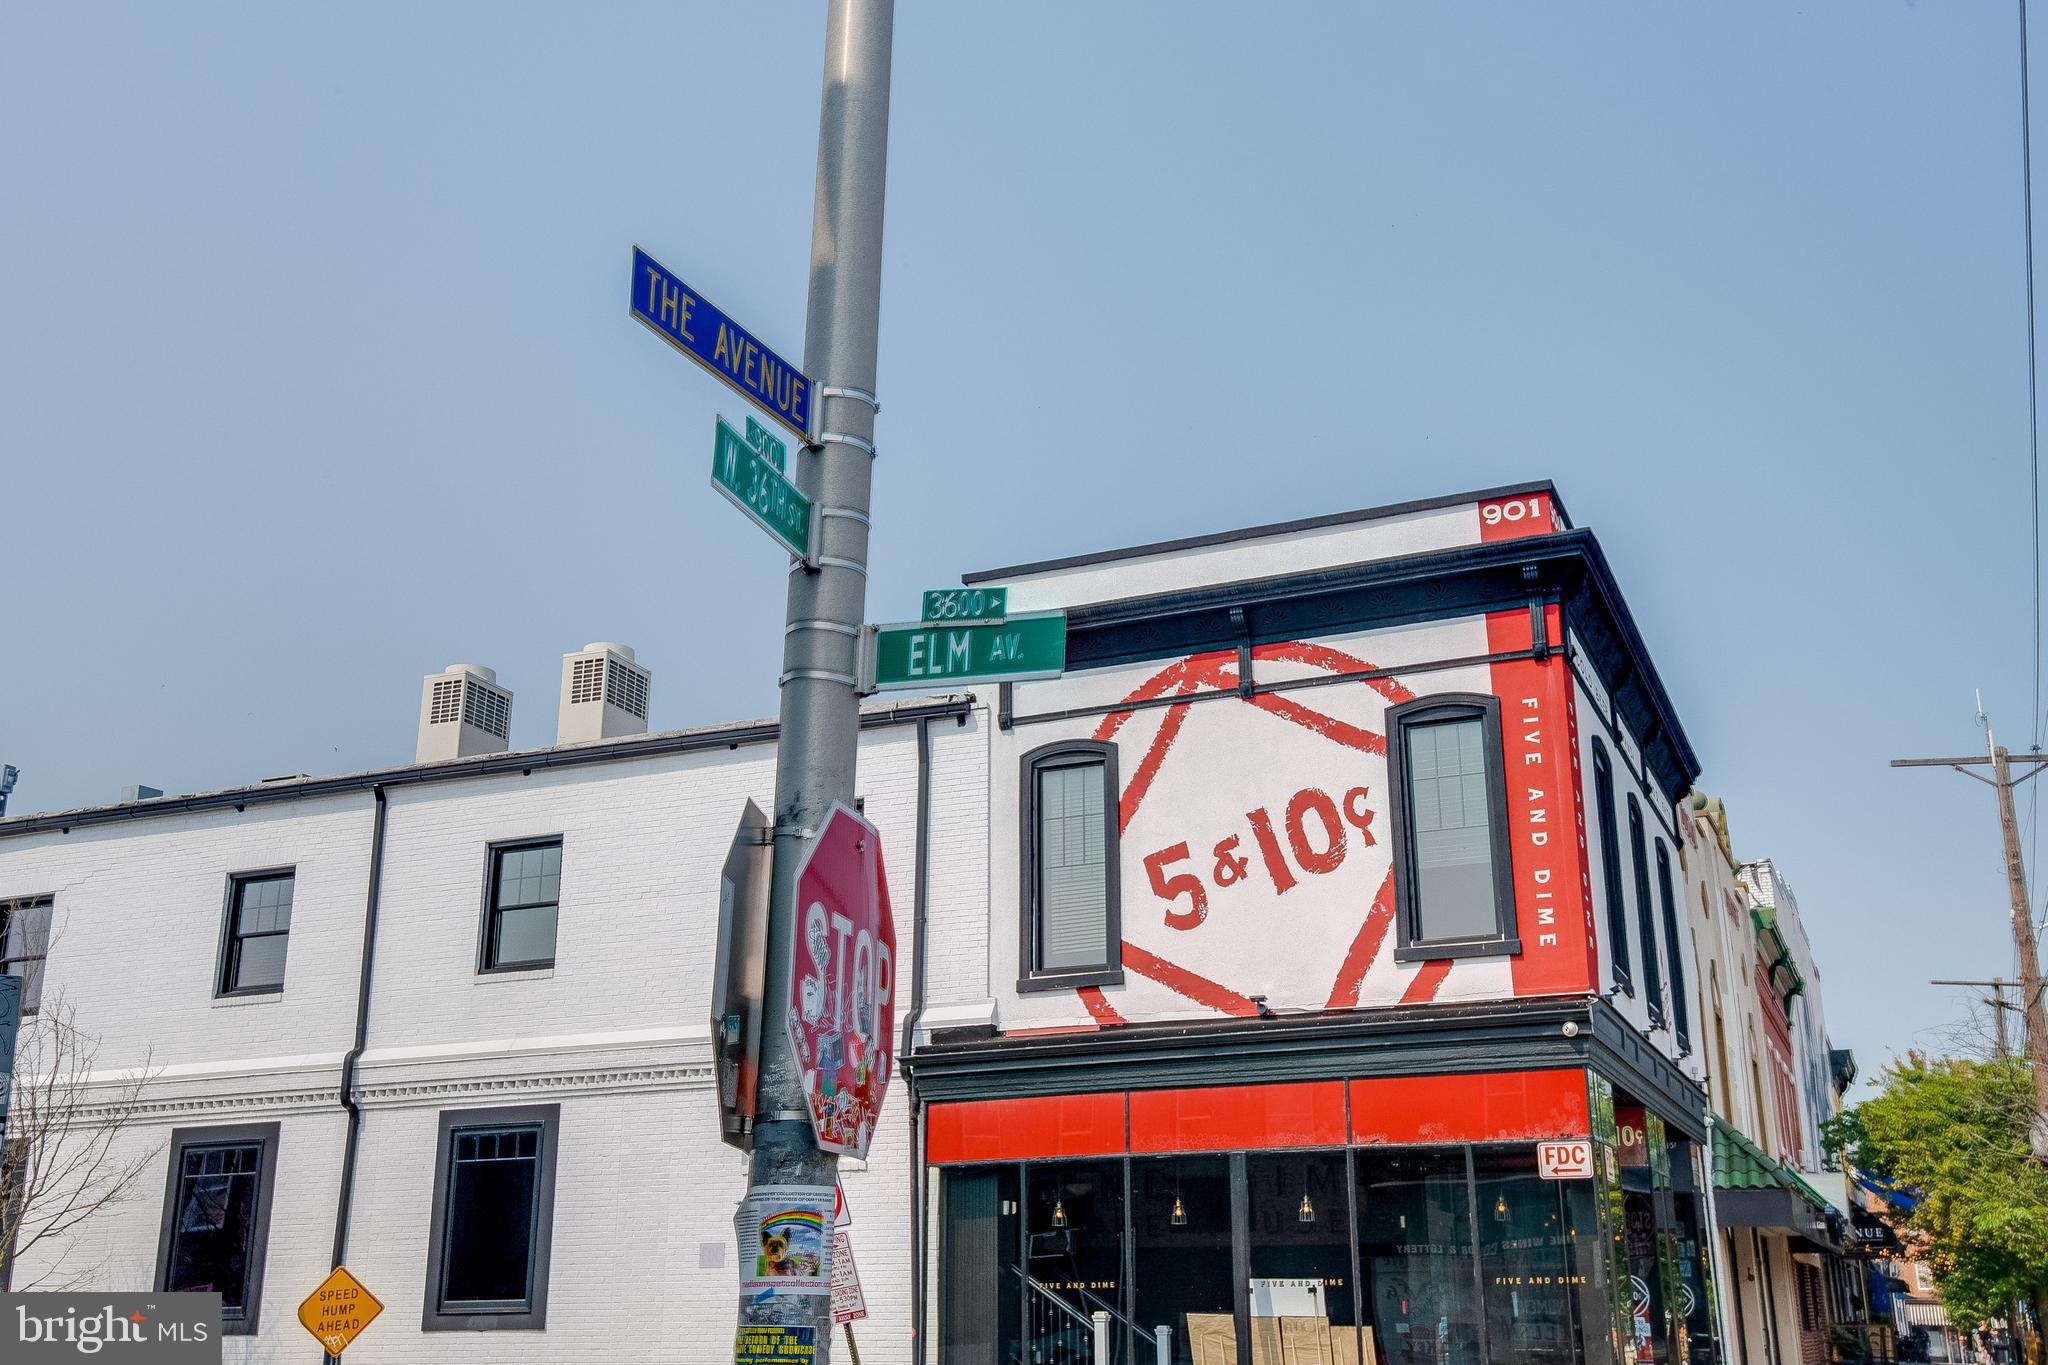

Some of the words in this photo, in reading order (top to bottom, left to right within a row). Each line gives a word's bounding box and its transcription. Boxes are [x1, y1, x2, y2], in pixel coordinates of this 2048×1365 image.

[647, 266, 696, 342] THE
[714, 322, 805, 423] AVENUE
[747, 460, 787, 520] 36TH
[1482, 498, 1541, 525] 901
[929, 590, 985, 619] 3600
[908, 630, 973, 676] ELM
[989, 633, 1024, 662] AV.
[1521, 697, 1542, 765] FIVE
[1527, 788, 1548, 846] AND
[1143, 841, 1208, 931] 5
[1213, 834, 1248, 887] &
[1534, 869, 1557, 946] DIME
[805, 901, 893, 1050] STOP
[1544, 1146, 1585, 1165] FDC
[320, 1288, 359, 1301] SPEED
[1091, 1281, 1115, 1289] DIME
[1318, 1279, 1343, 1287] DIME
[1495, 1277, 1521, 1285] FIVE
[1558, 1276, 1586, 1284] DIME
[322, 1304, 356, 1316] HUMP
[317, 1319, 360, 1332] AHEAD
[784, 1336, 798, 1344] THE
